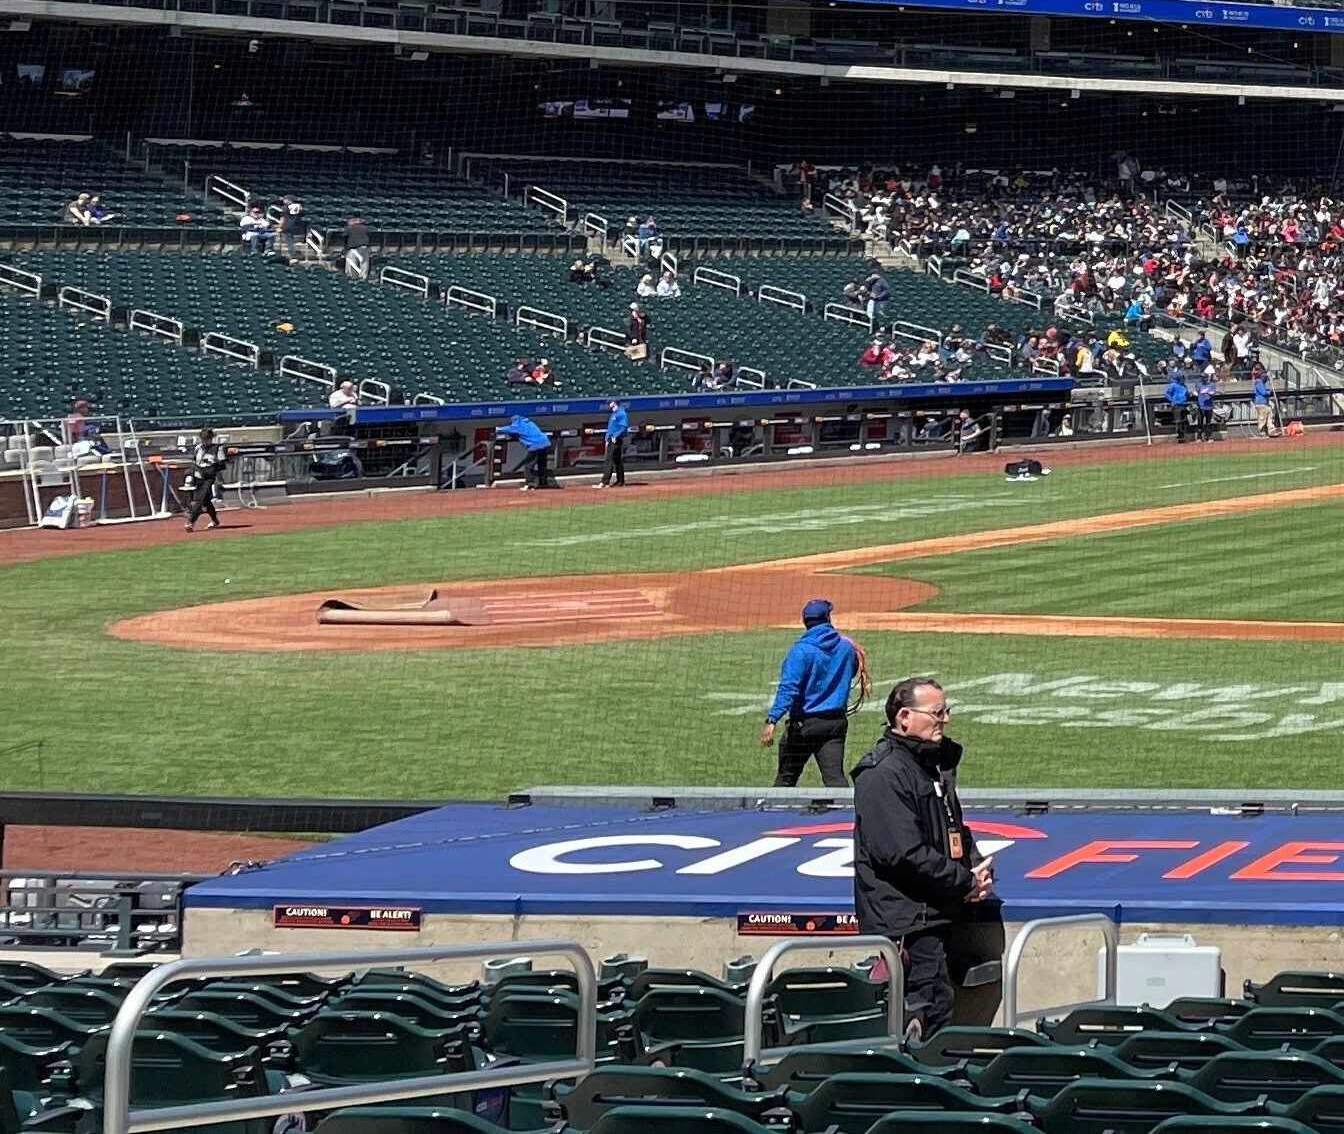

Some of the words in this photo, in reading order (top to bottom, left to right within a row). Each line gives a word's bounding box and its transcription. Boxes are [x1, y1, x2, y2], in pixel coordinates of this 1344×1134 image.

[286, 908, 328, 917] CAUTION!
[370, 910, 386, 918] BE
[387, 911, 412, 920] ALERT!
[748, 914, 792, 924] CAUTION!
[836, 916, 848, 924] BE
